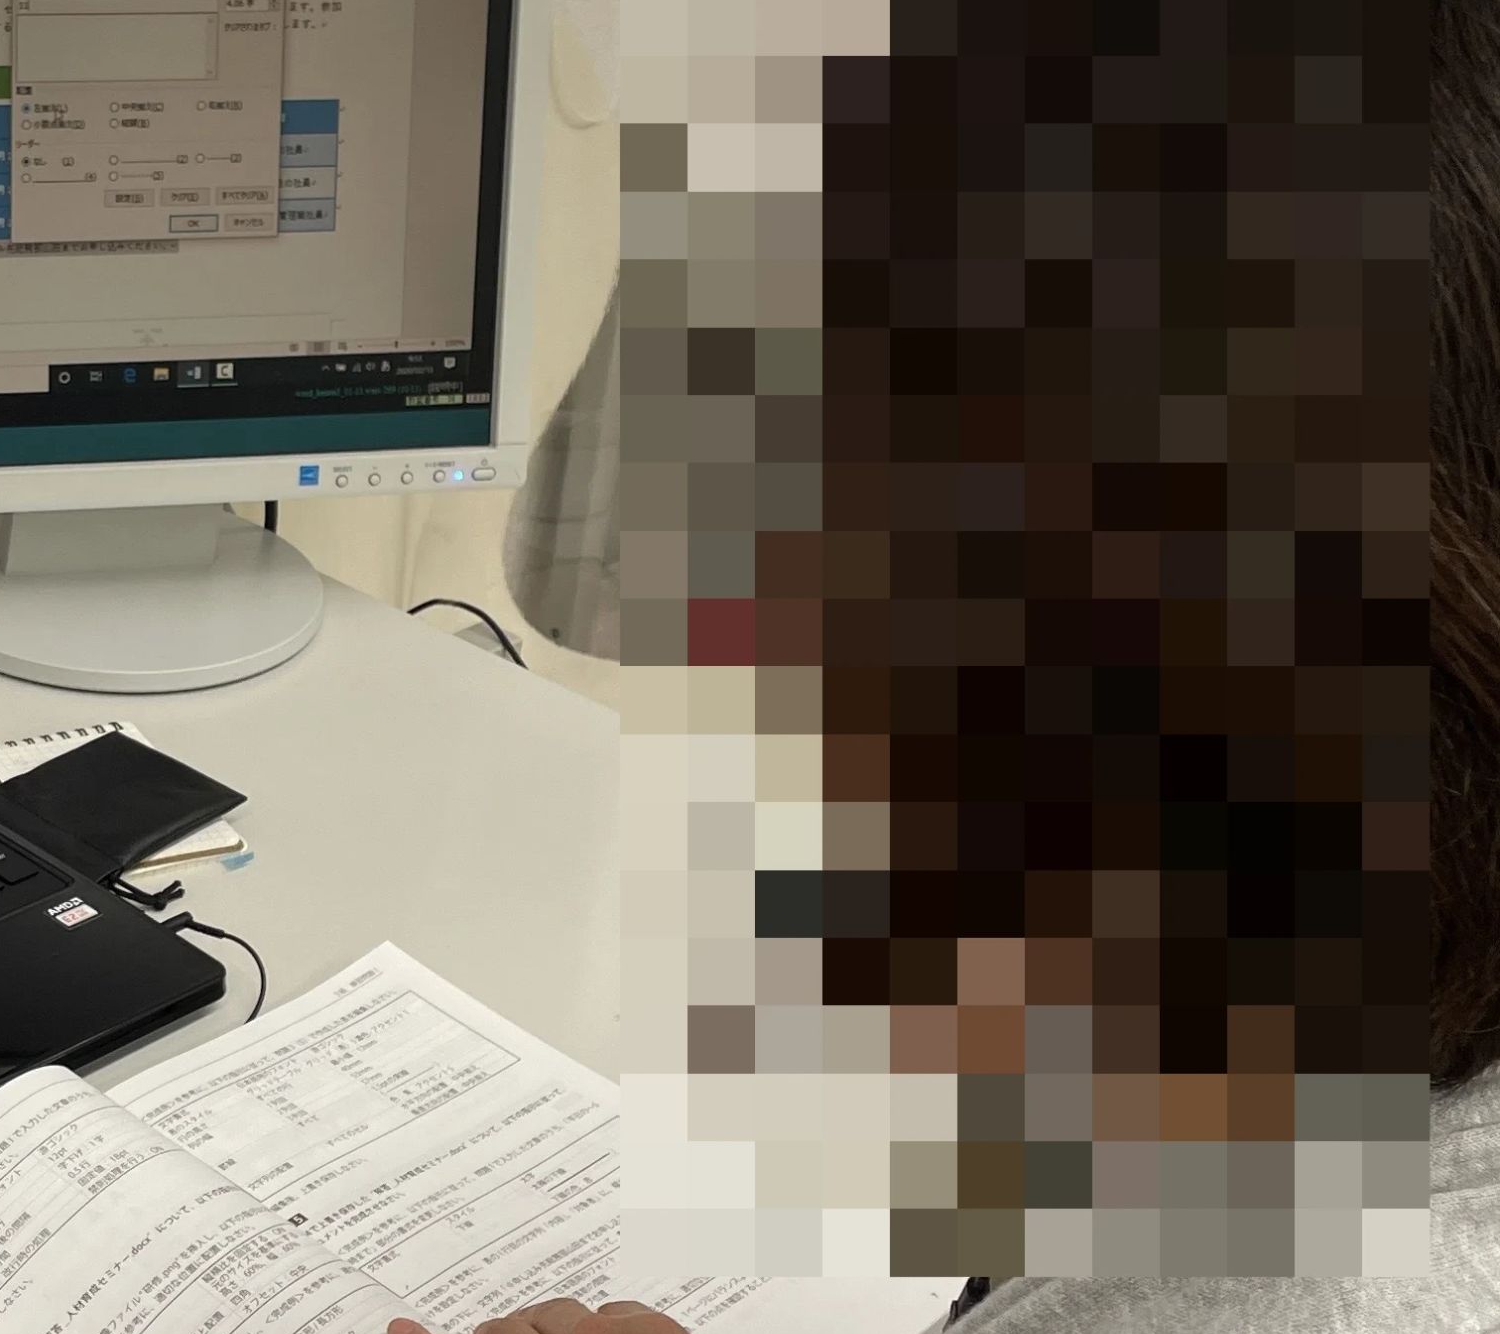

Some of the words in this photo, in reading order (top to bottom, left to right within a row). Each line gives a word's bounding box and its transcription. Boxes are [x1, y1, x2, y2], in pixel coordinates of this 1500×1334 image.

[47, 897, 75, 917] AMD
[47, 1146, 68, 1162] 12pt
[291, 1213, 308, 1226] 5
[1, 1227, 52, 1278] 改行時の処理
[229, 1285, 252, 1307] 四角
